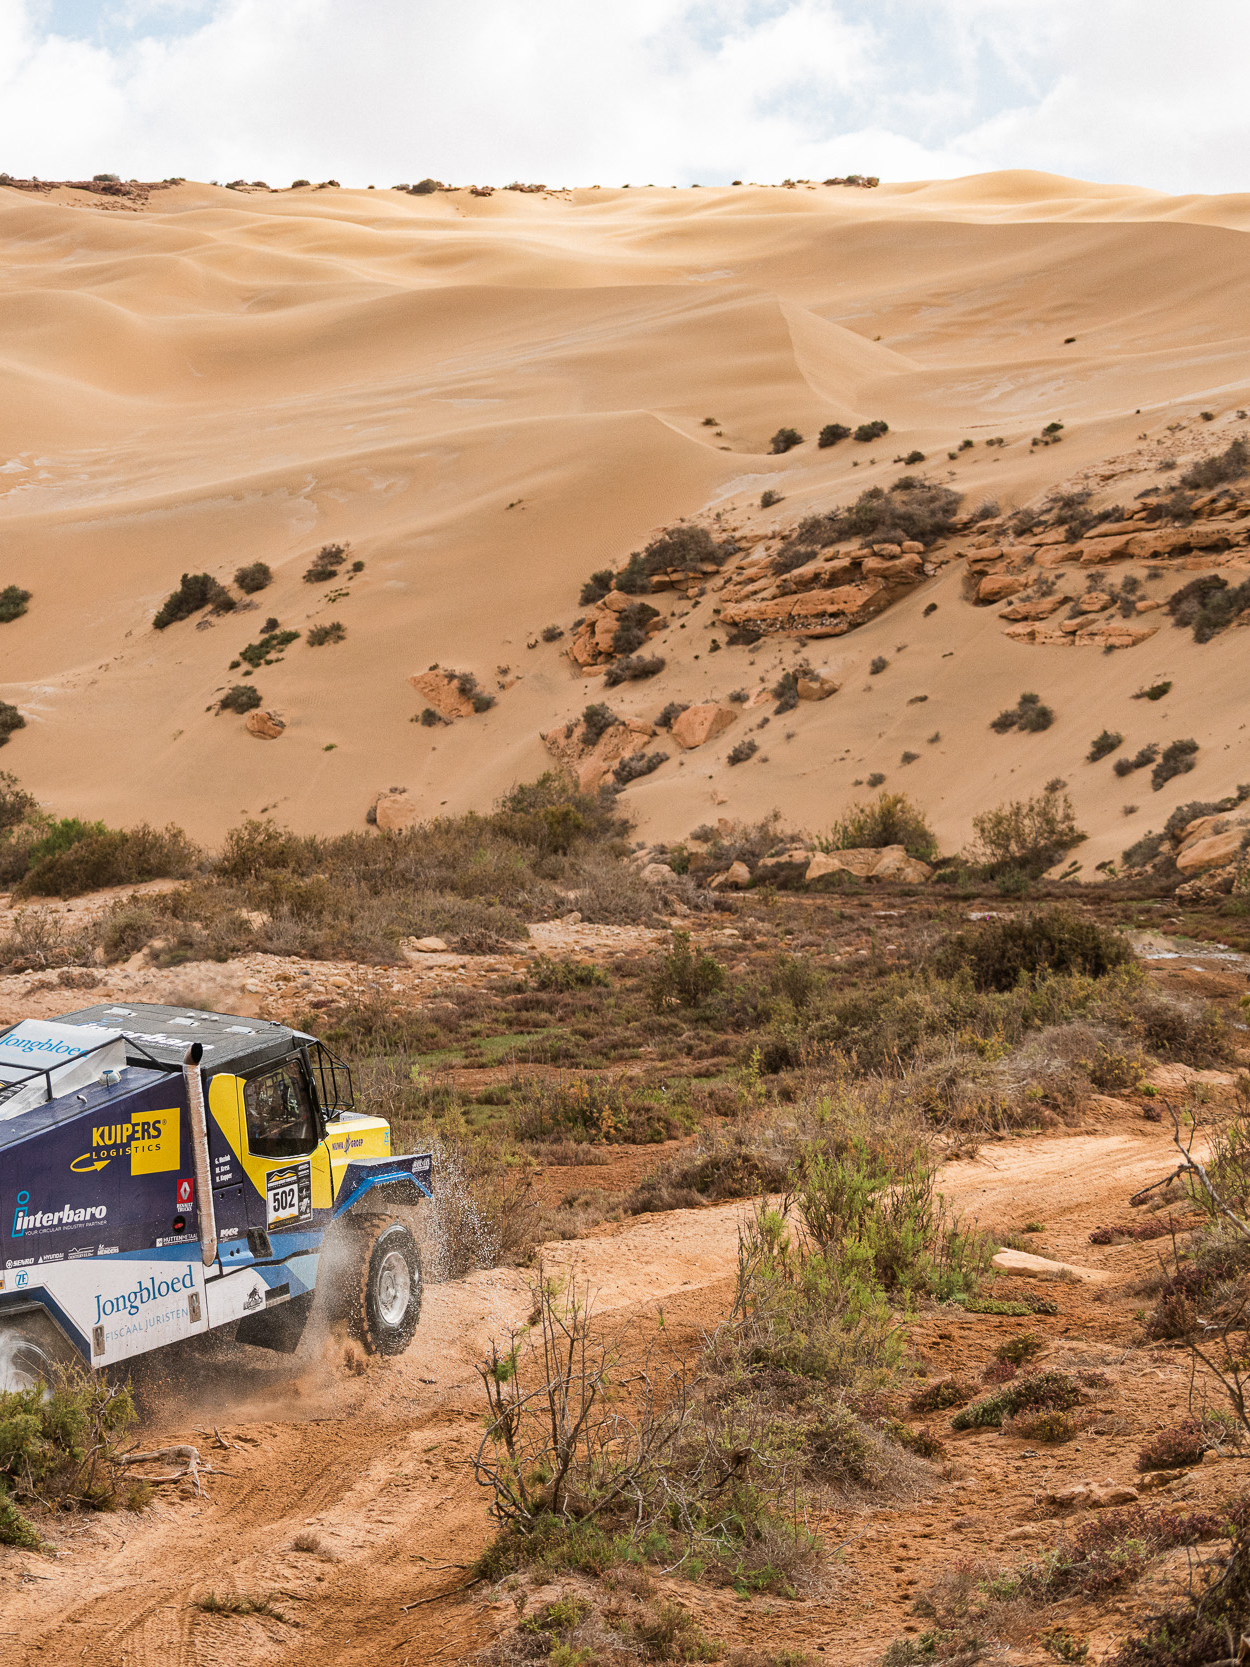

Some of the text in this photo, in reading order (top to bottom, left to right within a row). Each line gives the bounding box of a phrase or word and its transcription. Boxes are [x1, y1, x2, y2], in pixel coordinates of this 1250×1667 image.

[92, 1143, 161, 1159] LOGISTICS
[350, 1138, 363, 1148] GROEP
[273, 1187, 296, 1213] 502
[15, 1204, 107, 1231] interbaro
[39, 1226, 62, 1235] CIRCULAR
[62, 1222, 85, 1231] INDUSTRY
[85, 1219, 107, 1228] PARTNER
[43, 1252, 65, 1260] HYUNDAI
[16, 1273, 28, 1286] ZF
[94, 1264, 196, 1325] Jongbloed
[105, 1307, 189, 1342] FISCAAL JURISTEN
